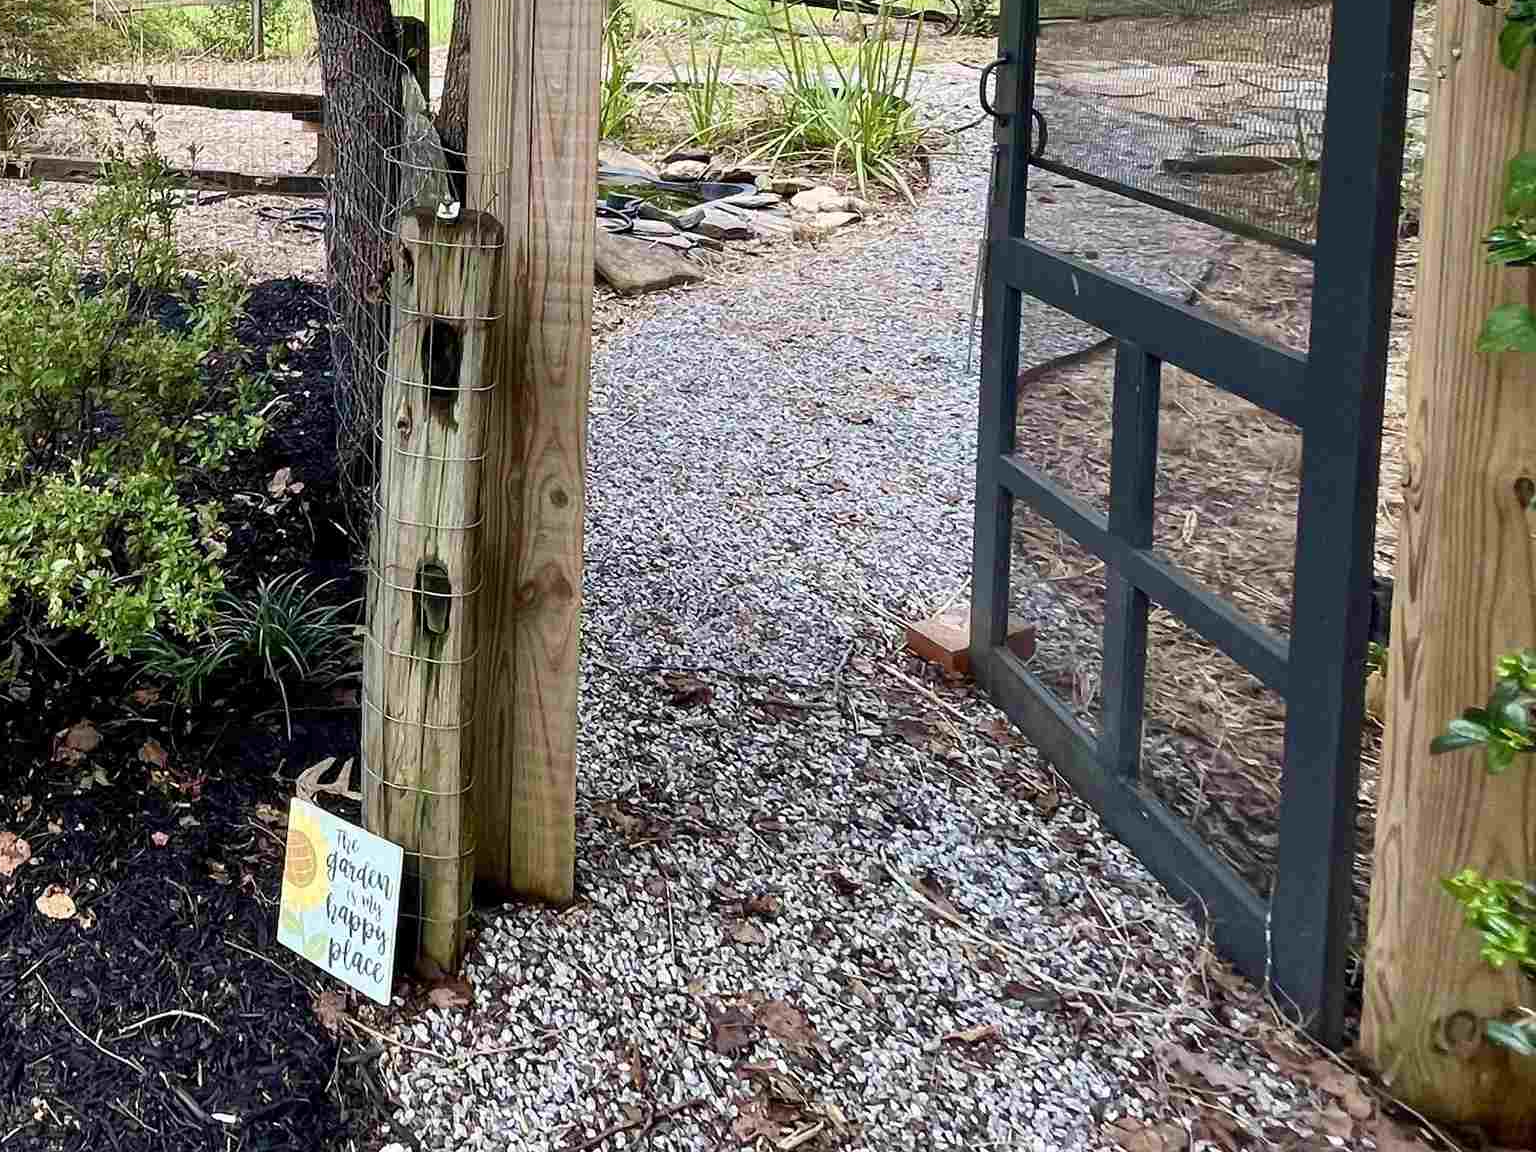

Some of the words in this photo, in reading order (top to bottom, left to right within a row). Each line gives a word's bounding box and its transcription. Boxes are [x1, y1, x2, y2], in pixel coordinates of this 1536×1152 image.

[336, 829, 360, 853] The
[327, 851, 393, 901] garden
[326, 892, 386, 955] happy
[346, 889, 357, 906] is
[362, 898, 383, 922] my
[328, 937, 385, 984] place
